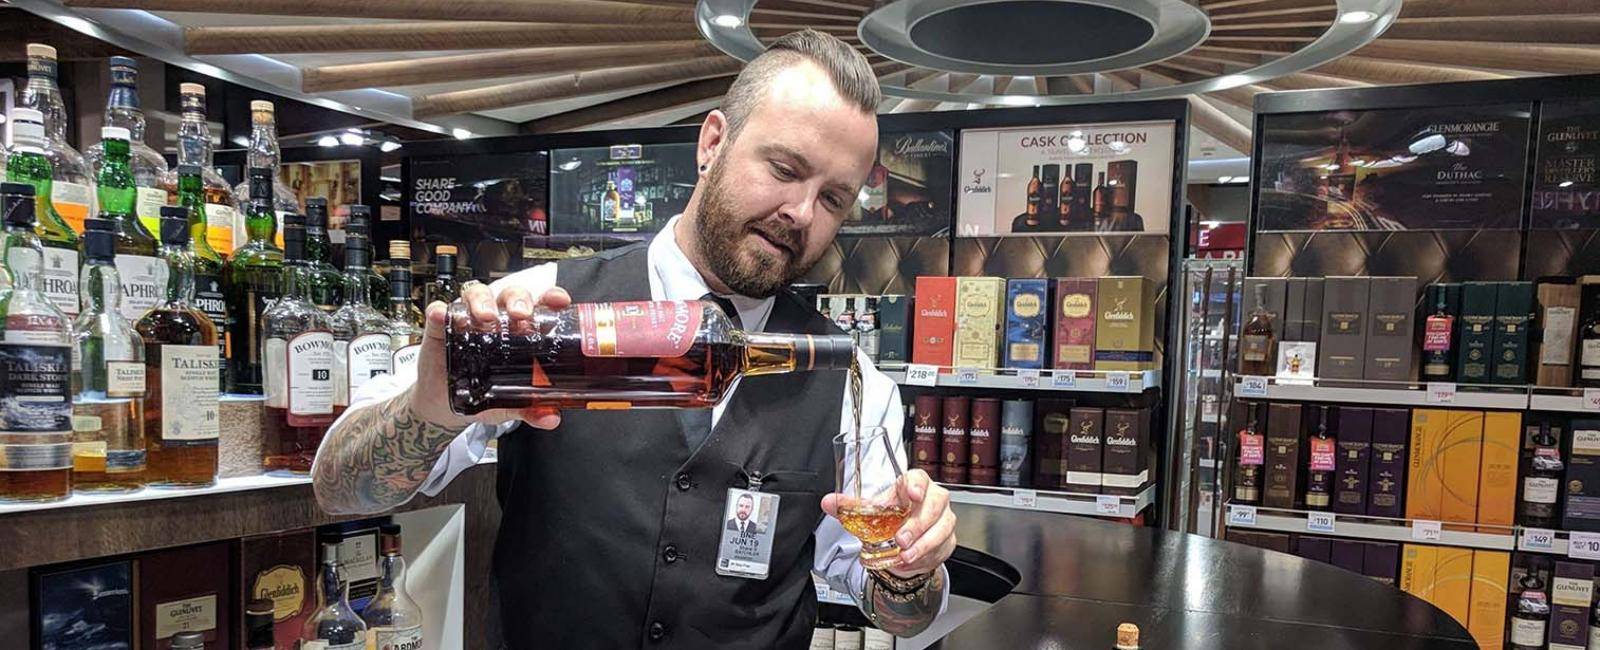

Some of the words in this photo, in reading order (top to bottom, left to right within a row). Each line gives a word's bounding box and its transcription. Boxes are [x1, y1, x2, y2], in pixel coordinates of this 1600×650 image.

[1021, 136, 1056, 148] CASK
[1437, 170, 1484, 181] DUTHAC
[415, 178, 456, 191] SHARE
[415, 190, 451, 203] GOOD
[316, 370, 327, 379] 10
[206, 410, 215, 421] 10
[729, 537, 747, 546] JUN
